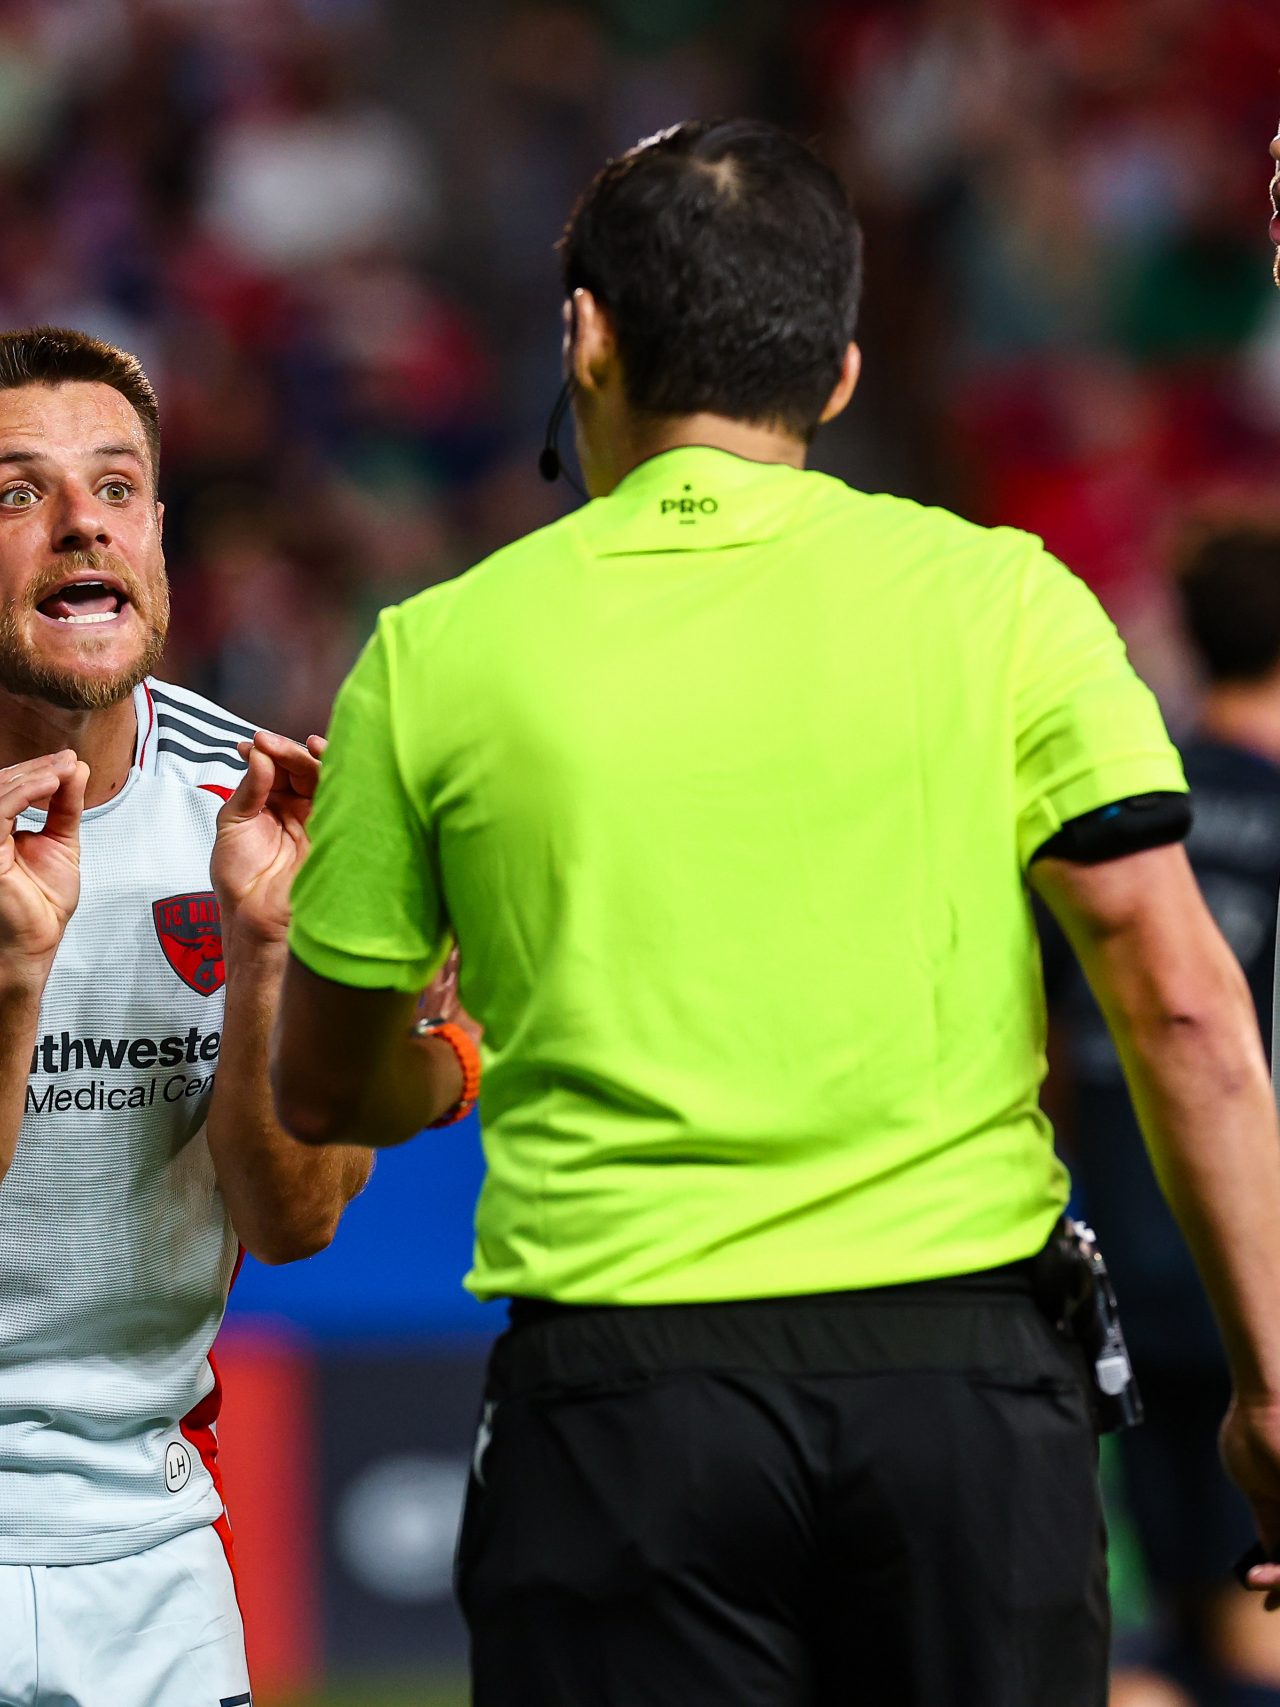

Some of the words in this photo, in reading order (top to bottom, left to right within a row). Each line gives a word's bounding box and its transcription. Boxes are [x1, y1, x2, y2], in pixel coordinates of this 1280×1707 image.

[661, 498, 718, 514] PRO
[164, 904, 183, 929] FC
[24, 1079, 157, 1113] Medical
[169, 1455, 186, 1480] LH
